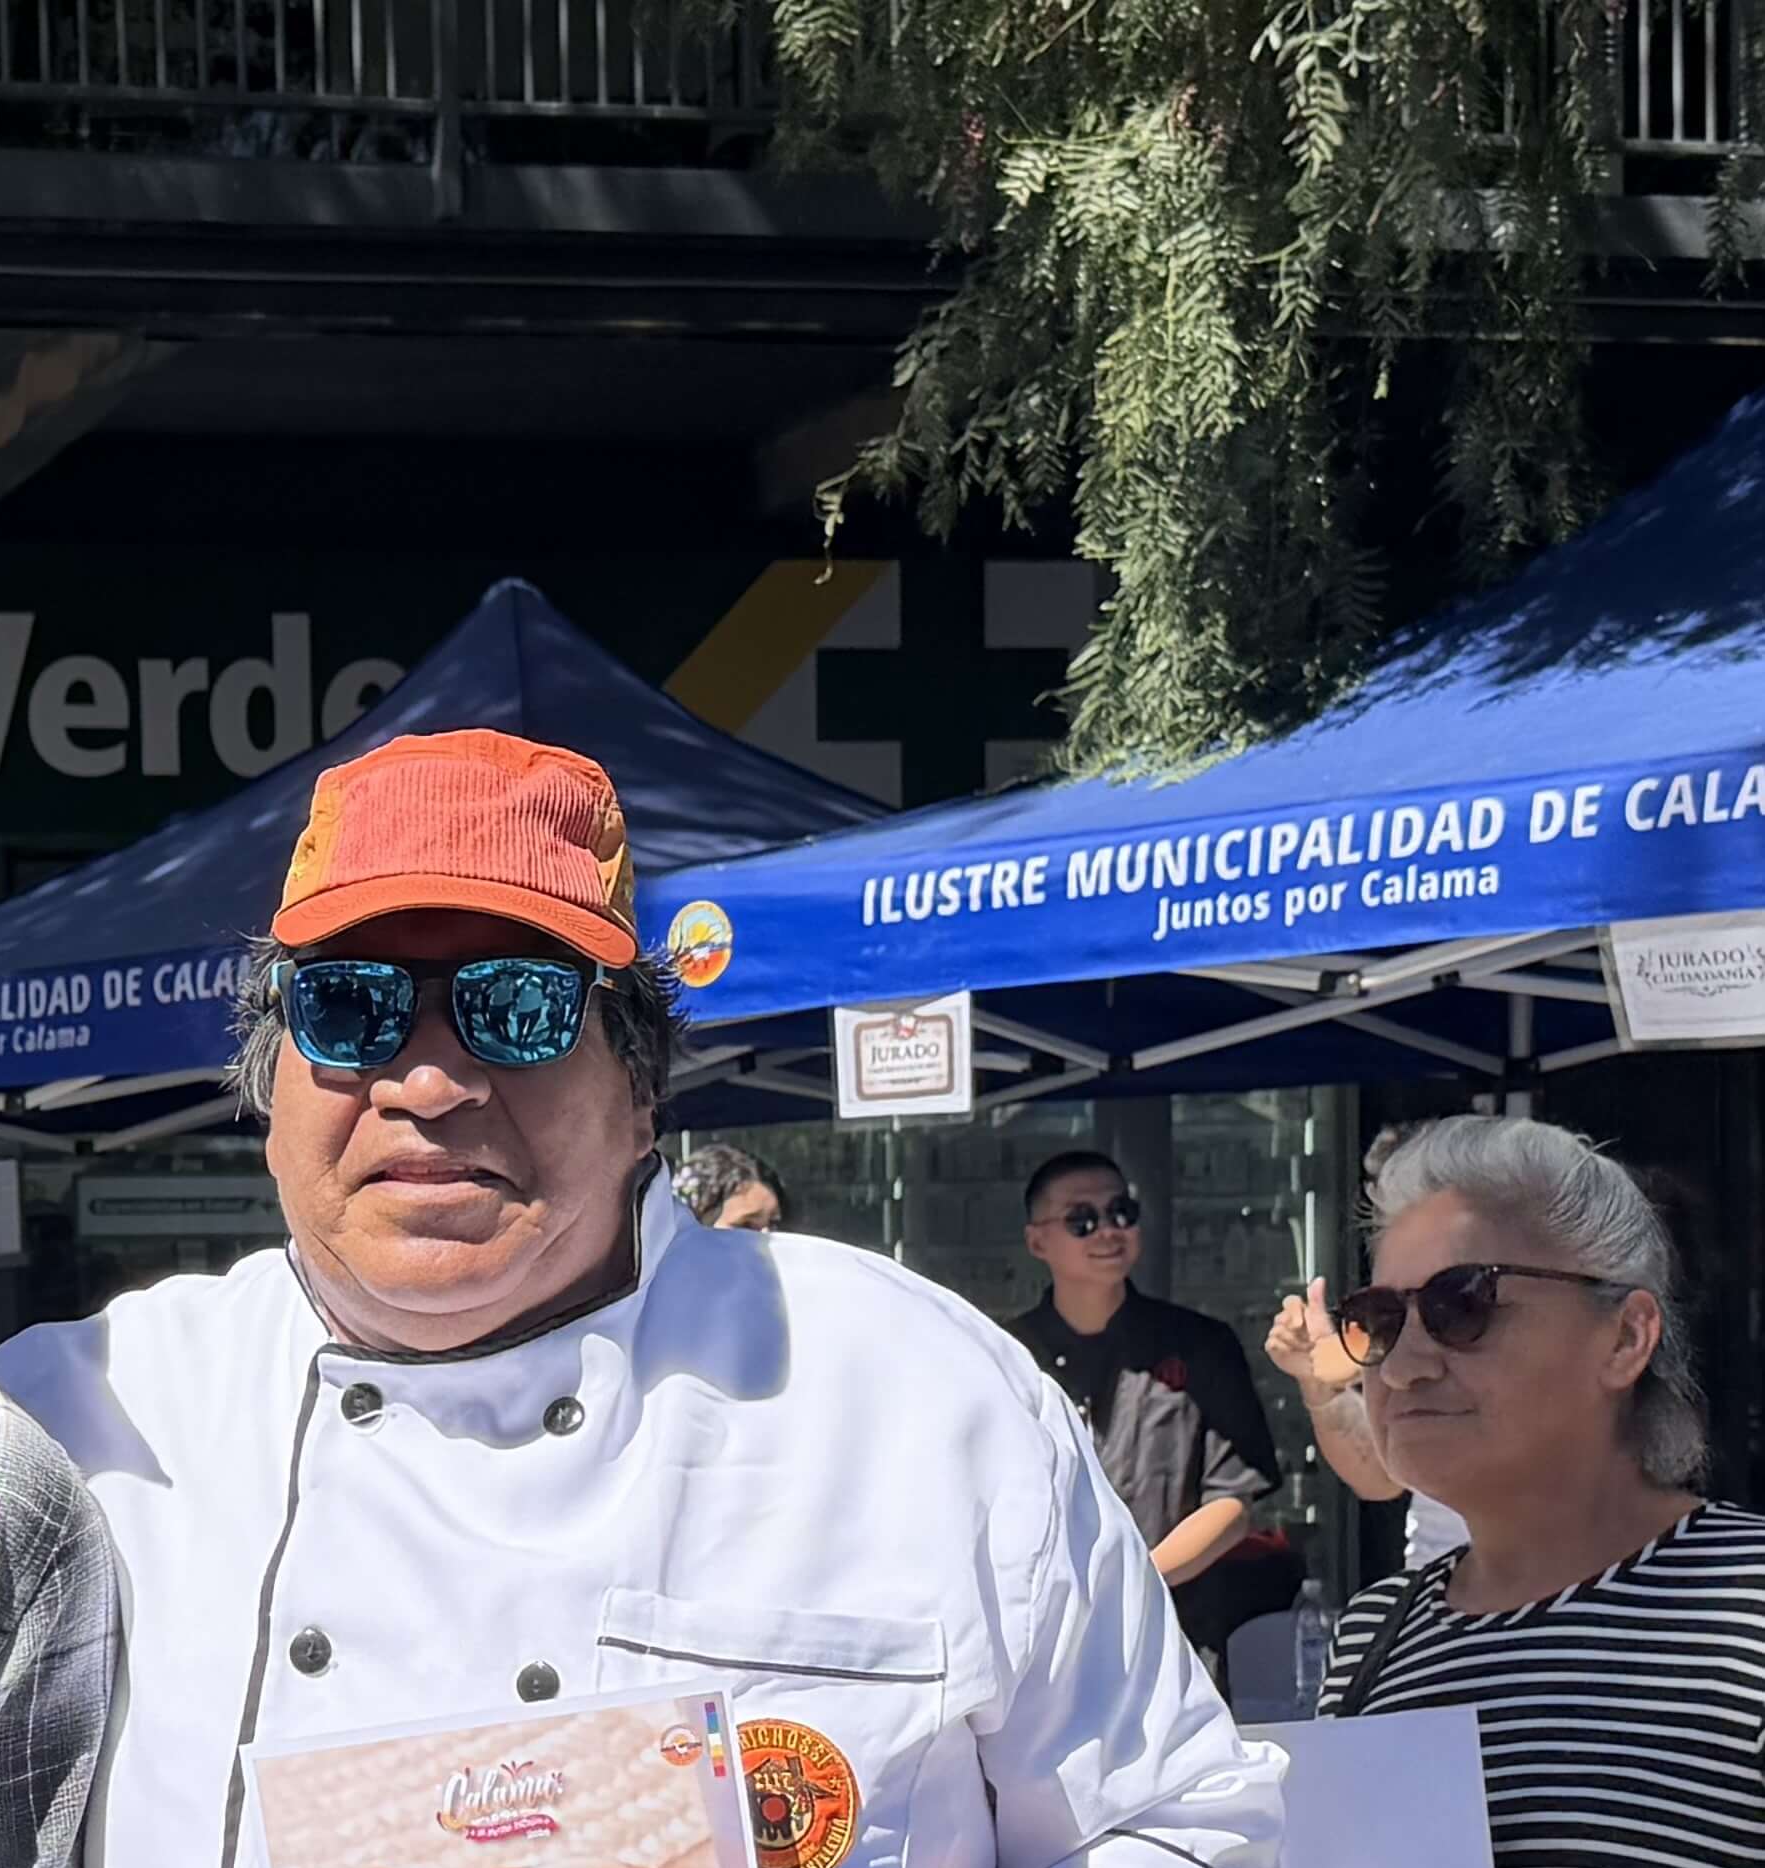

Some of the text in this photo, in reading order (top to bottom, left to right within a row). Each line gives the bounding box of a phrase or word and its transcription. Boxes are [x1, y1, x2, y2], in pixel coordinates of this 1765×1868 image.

[861, 763, 1765, 927] ILUSTRE MUNICIPALIDAD DE CALA
[1152, 863, 1501, 942] Juntos por Calama
[1658, 948, 1746, 970] JURADO
[103, 967, 143, 1010] DE
[153, 955, 251, 1003] CALA
[12, 1024, 91, 1054] Calama
[871, 1043, 939, 1065] JURADO
